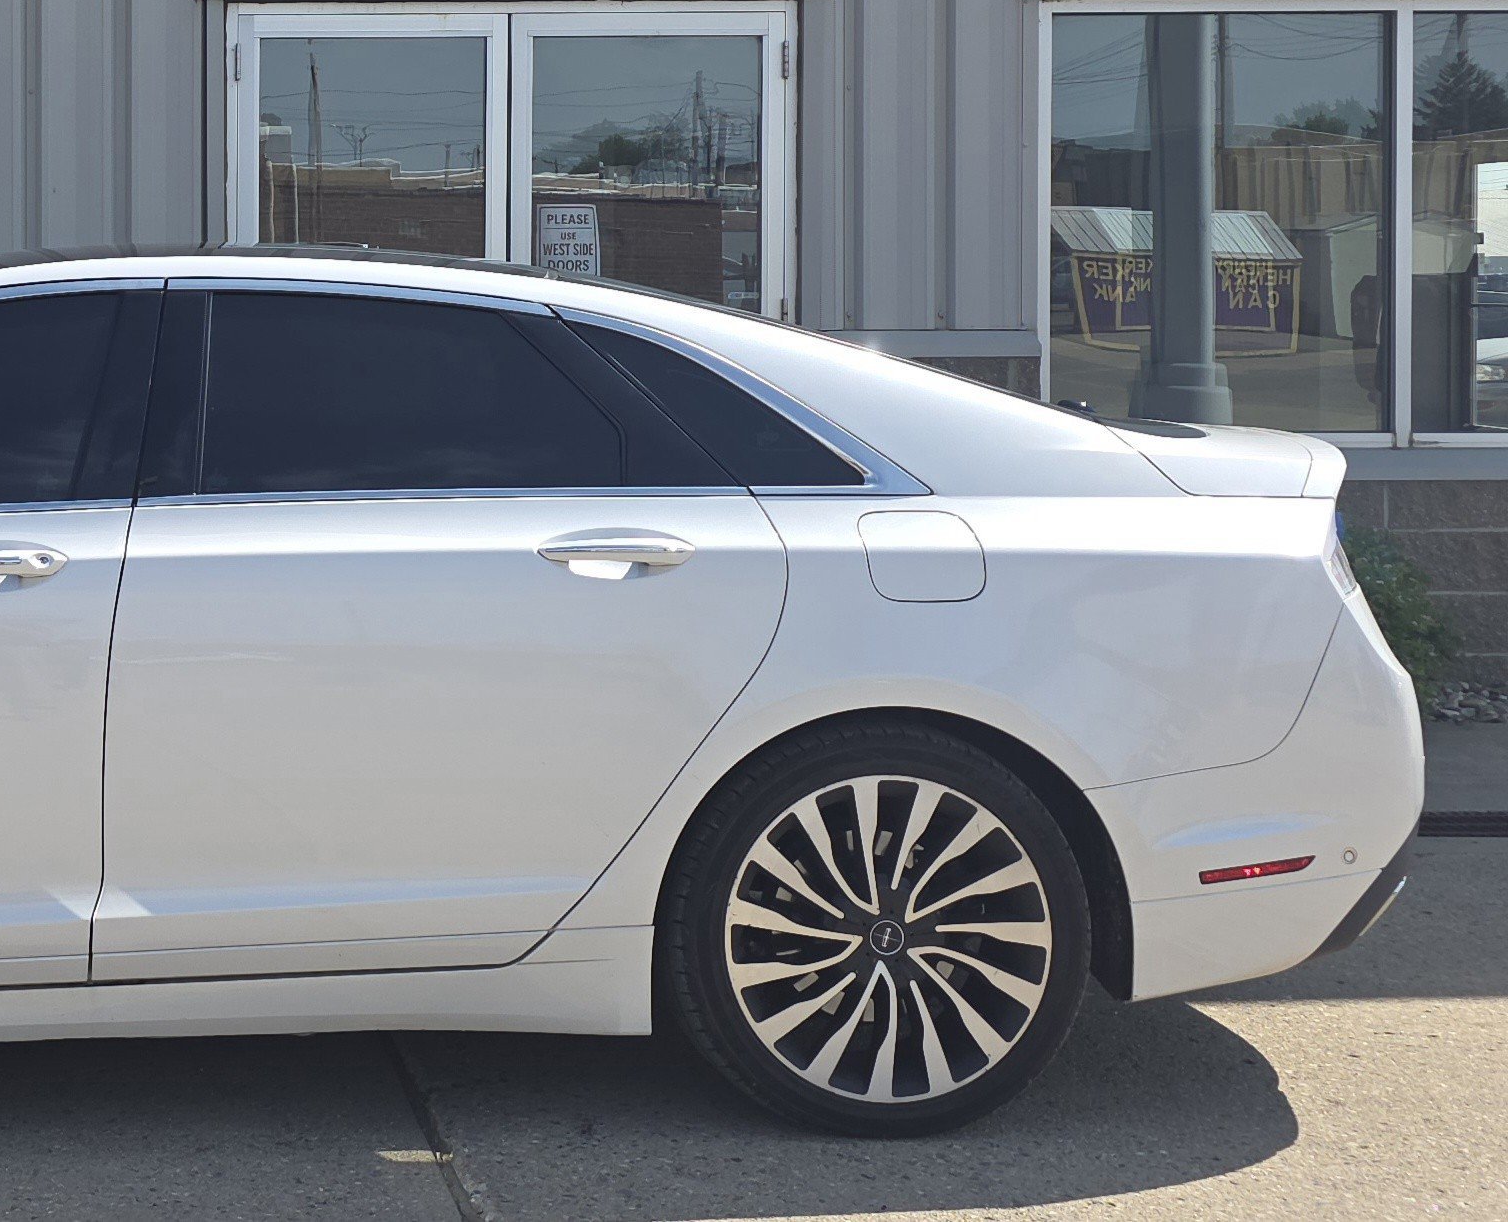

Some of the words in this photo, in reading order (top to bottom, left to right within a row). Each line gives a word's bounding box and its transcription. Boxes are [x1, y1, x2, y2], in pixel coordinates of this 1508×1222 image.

[547, 214, 590, 225] PLEASE
[560, 232, 577, 241] USE
[543, 243, 570, 256] WEST
[573, 243, 594, 256] SIDE
[547, 259, 590, 272] DOORS
